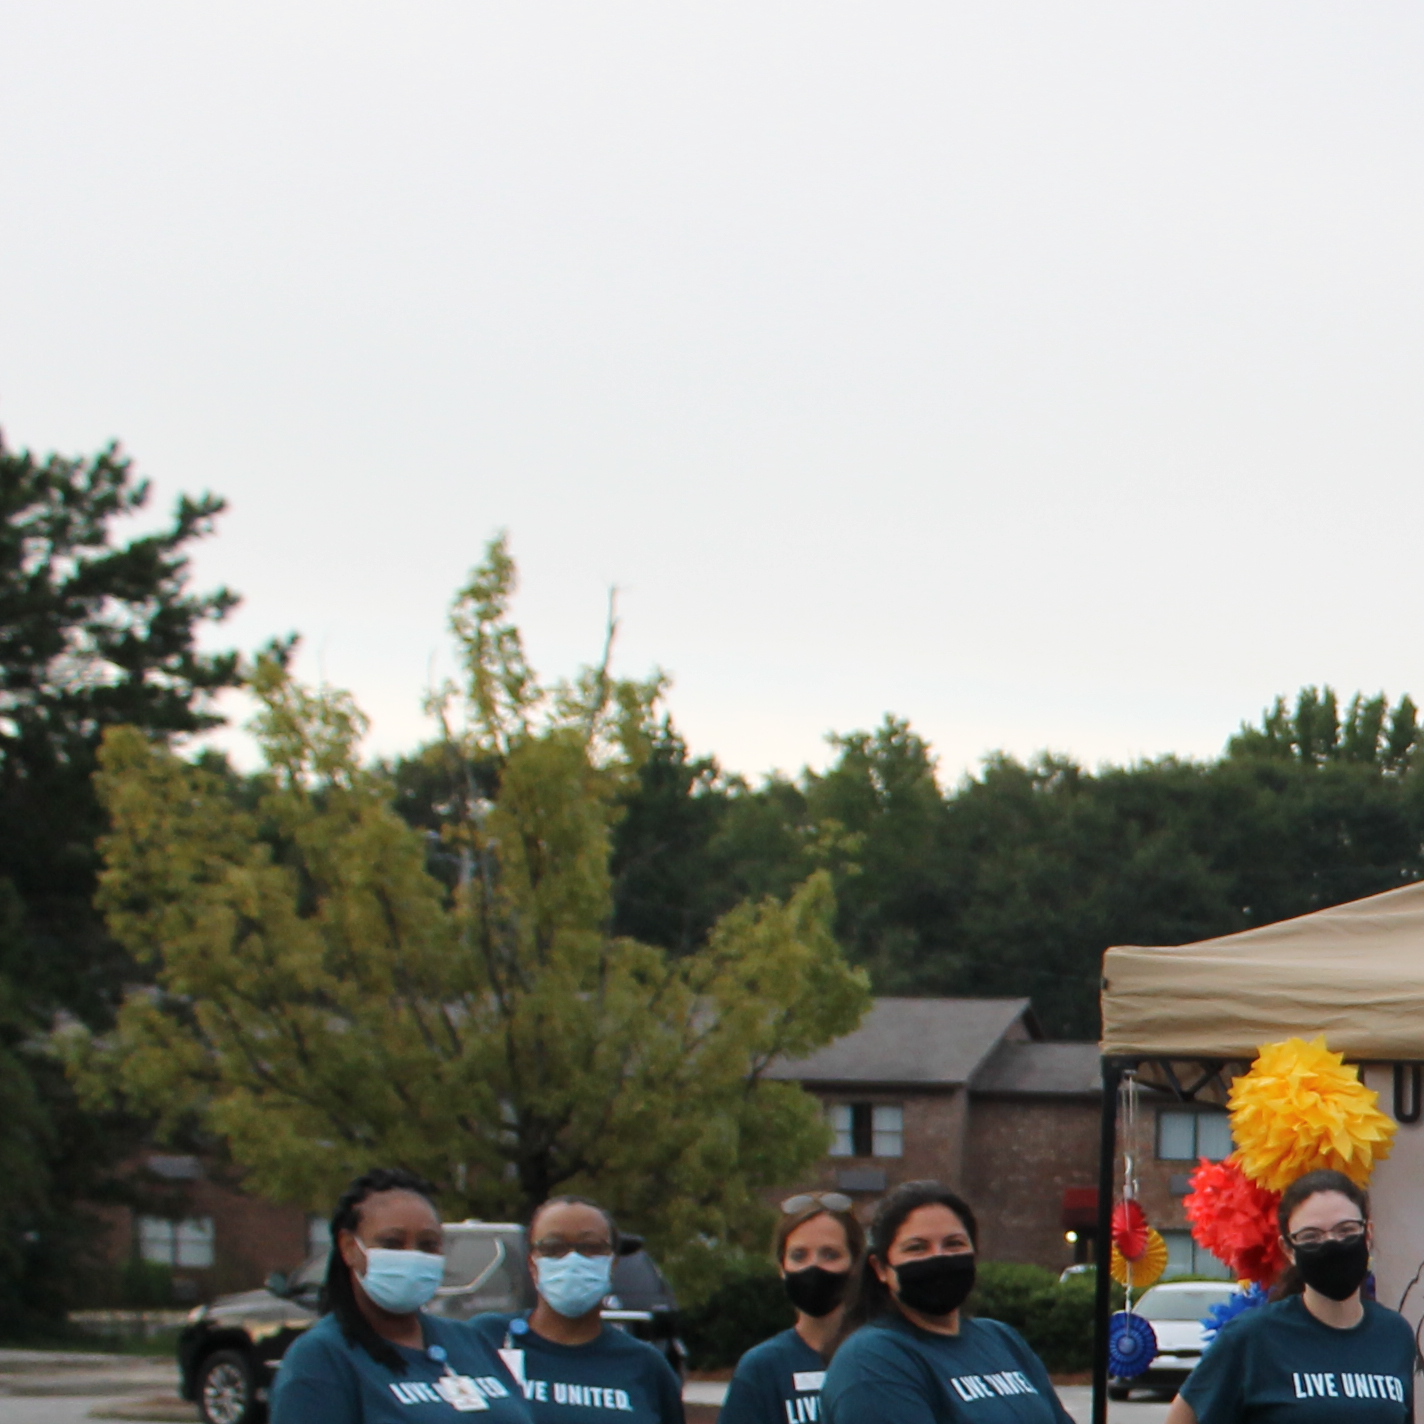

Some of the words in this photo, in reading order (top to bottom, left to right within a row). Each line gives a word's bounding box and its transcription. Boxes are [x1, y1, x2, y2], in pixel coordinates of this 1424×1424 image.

[388, 1382, 442, 1405] LIVE
[951, 1374, 995, 1402] LIVE
[1292, 1372, 1339, 1399] LIVE
[1341, 1372, 1404, 1403] UNITED
